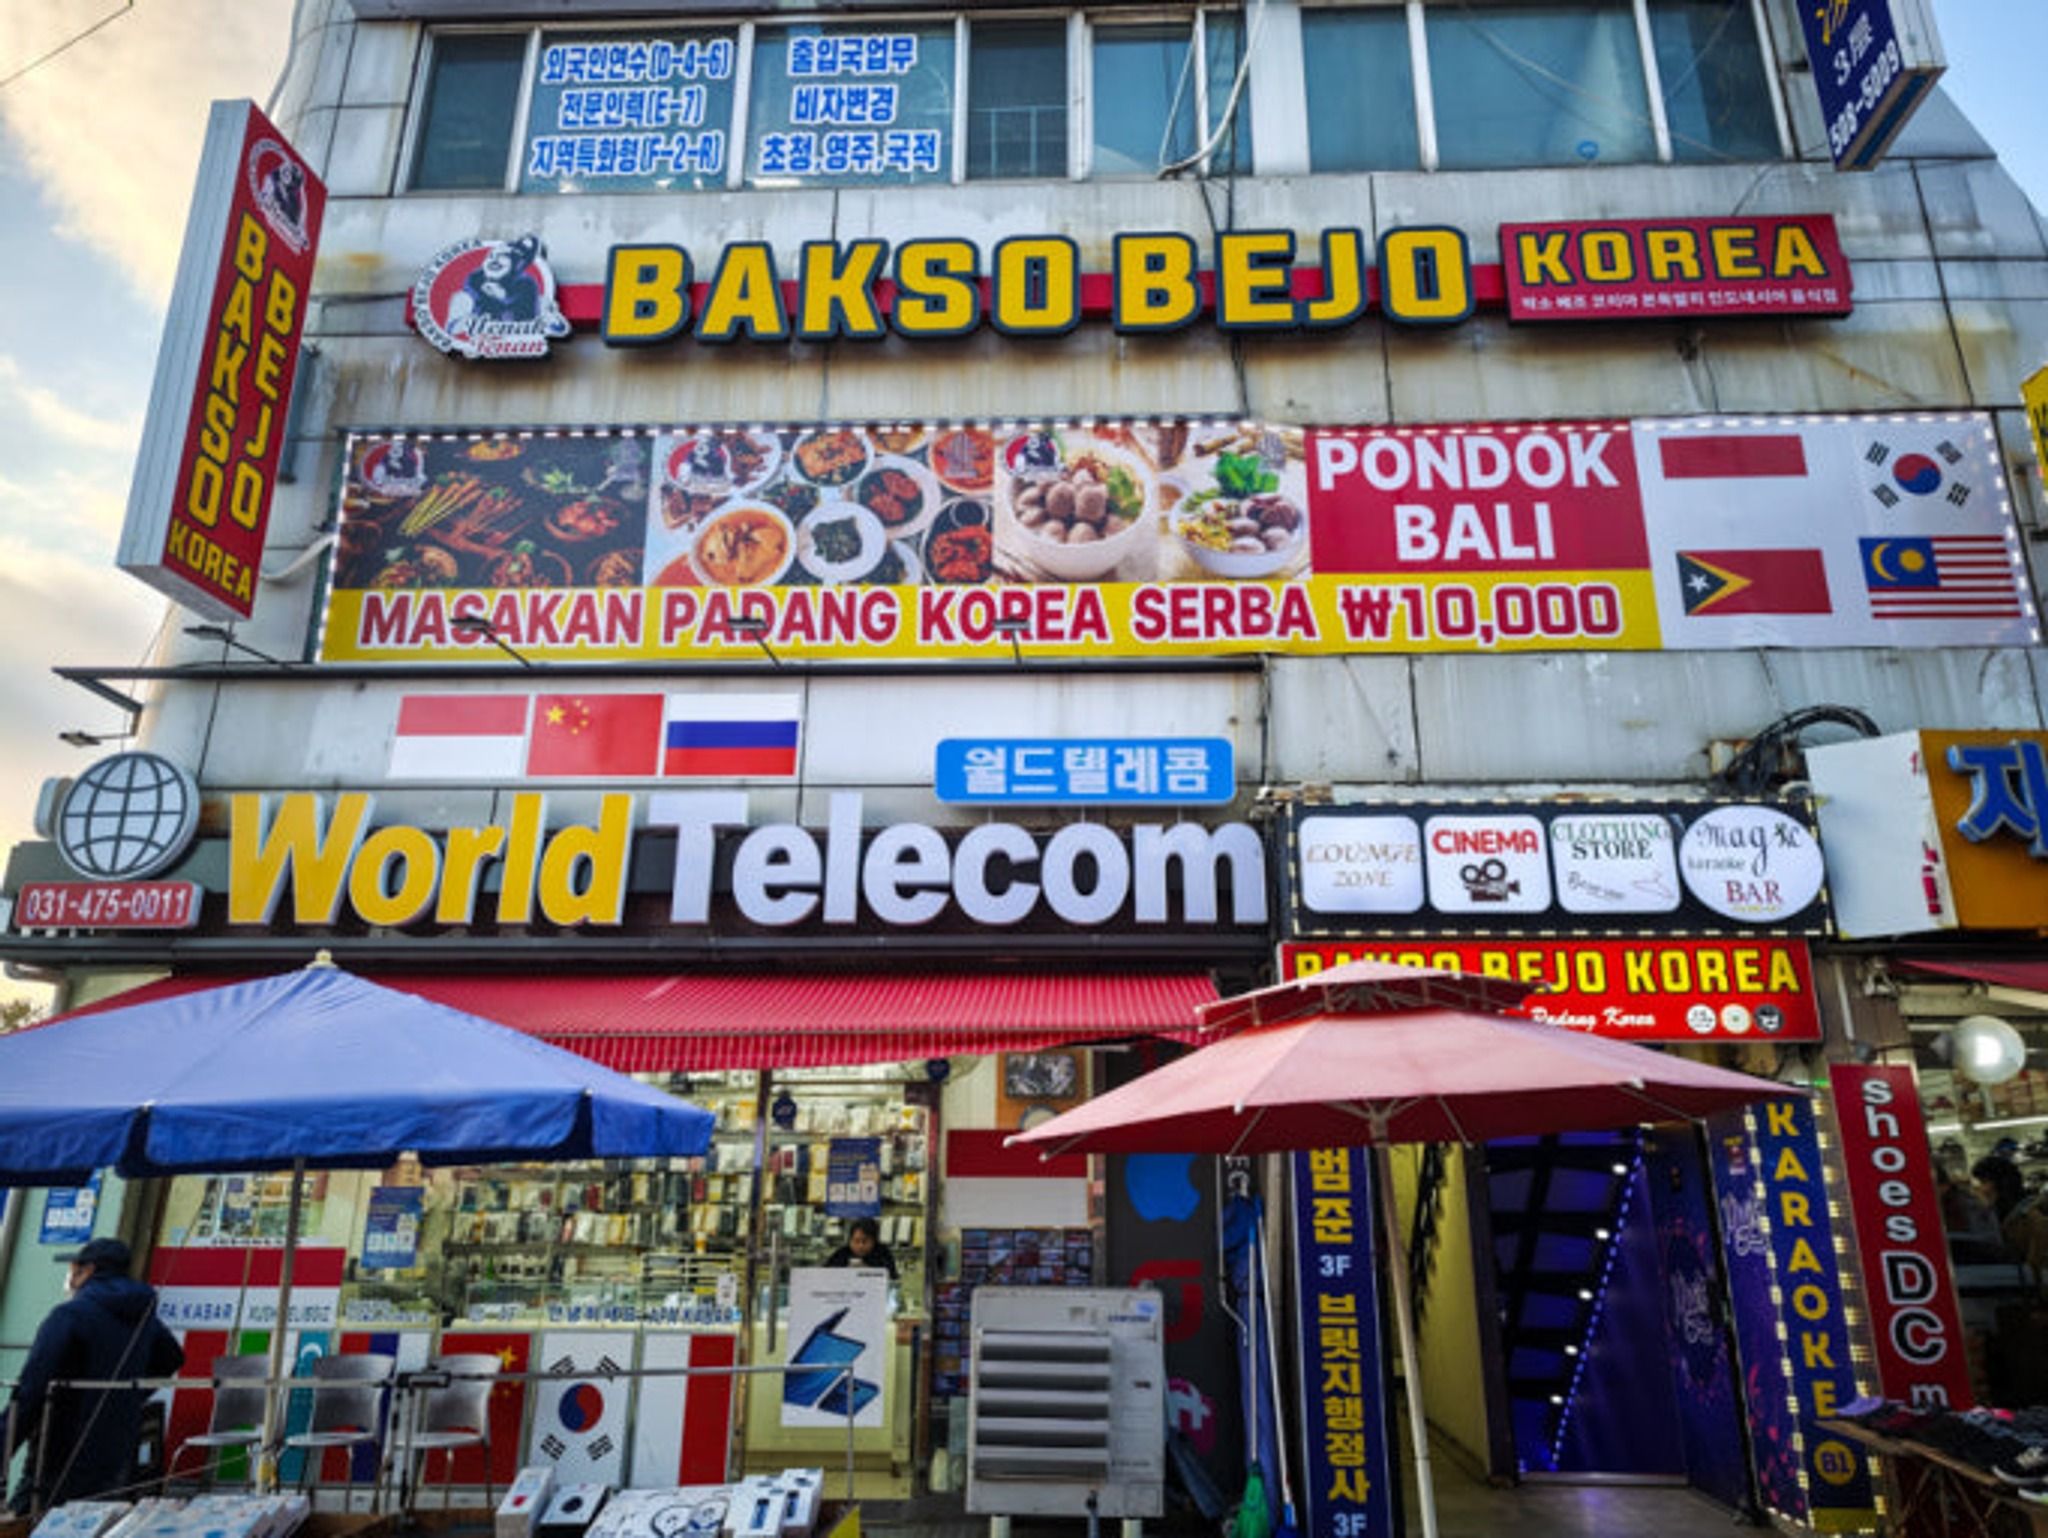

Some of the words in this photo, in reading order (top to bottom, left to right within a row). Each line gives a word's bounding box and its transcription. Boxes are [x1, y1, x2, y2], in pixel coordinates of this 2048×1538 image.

[543, 40, 732, 83] 외국인연수(D-4-6)
[788, 35, 917, 75] 출입국업무
[560, 84, 707, 128] 전문인력(E-7)
[792, 84, 897, 123] 비자변경
[529, 130, 724, 175] 지역특화형(F-2-R)
[1517, 224, 1829, 286] KOREA
[602, 237, 1081, 345] BAKSO
[1113, 225, 1476, 335] BEJO
[186, 208, 269, 532] BAKSO
[229, 266, 299, 534] BEJO
[1315, 431, 1620, 491] PONDOK
[1394, 501, 1556, 562] BALI
[166, 515, 254, 606] KOREA
[358, 591, 645, 649] MASAKAN
[661, 588, 899, 646] PADANG
[919, 587, 1110, 645] KOREA
[1132, 583, 1318, 641] SERBA
[1341, 582, 1622, 644] ₩10,000
[961, 745, 1213, 796] 월드텔레콤
[1431, 828, 1540, 855] CINEMA
[1551, 820, 1669, 842] CLOTHING
[1571, 840, 1653, 860] STORE
[228, 792, 634, 926] World
[647, 791, 1270, 927] Telecom
[1332, 870, 1395, 888] ZONE
[26, 885, 190, 924] 031-475-0011
[1725, 879, 1782, 904] BAR
[1623, 949, 1800, 993] KOREA
[1859, 1077, 1918, 1243] shoes
[1318, 1253, 1352, 1278] 3F
[1766, 1102, 1837, 1418] KARAOKE
[1879, 1250, 1947, 1366] DC
[1317, 1291, 1371, 1505] 브릿지행정사
[1332, 1512, 1367, 1538] 3F
